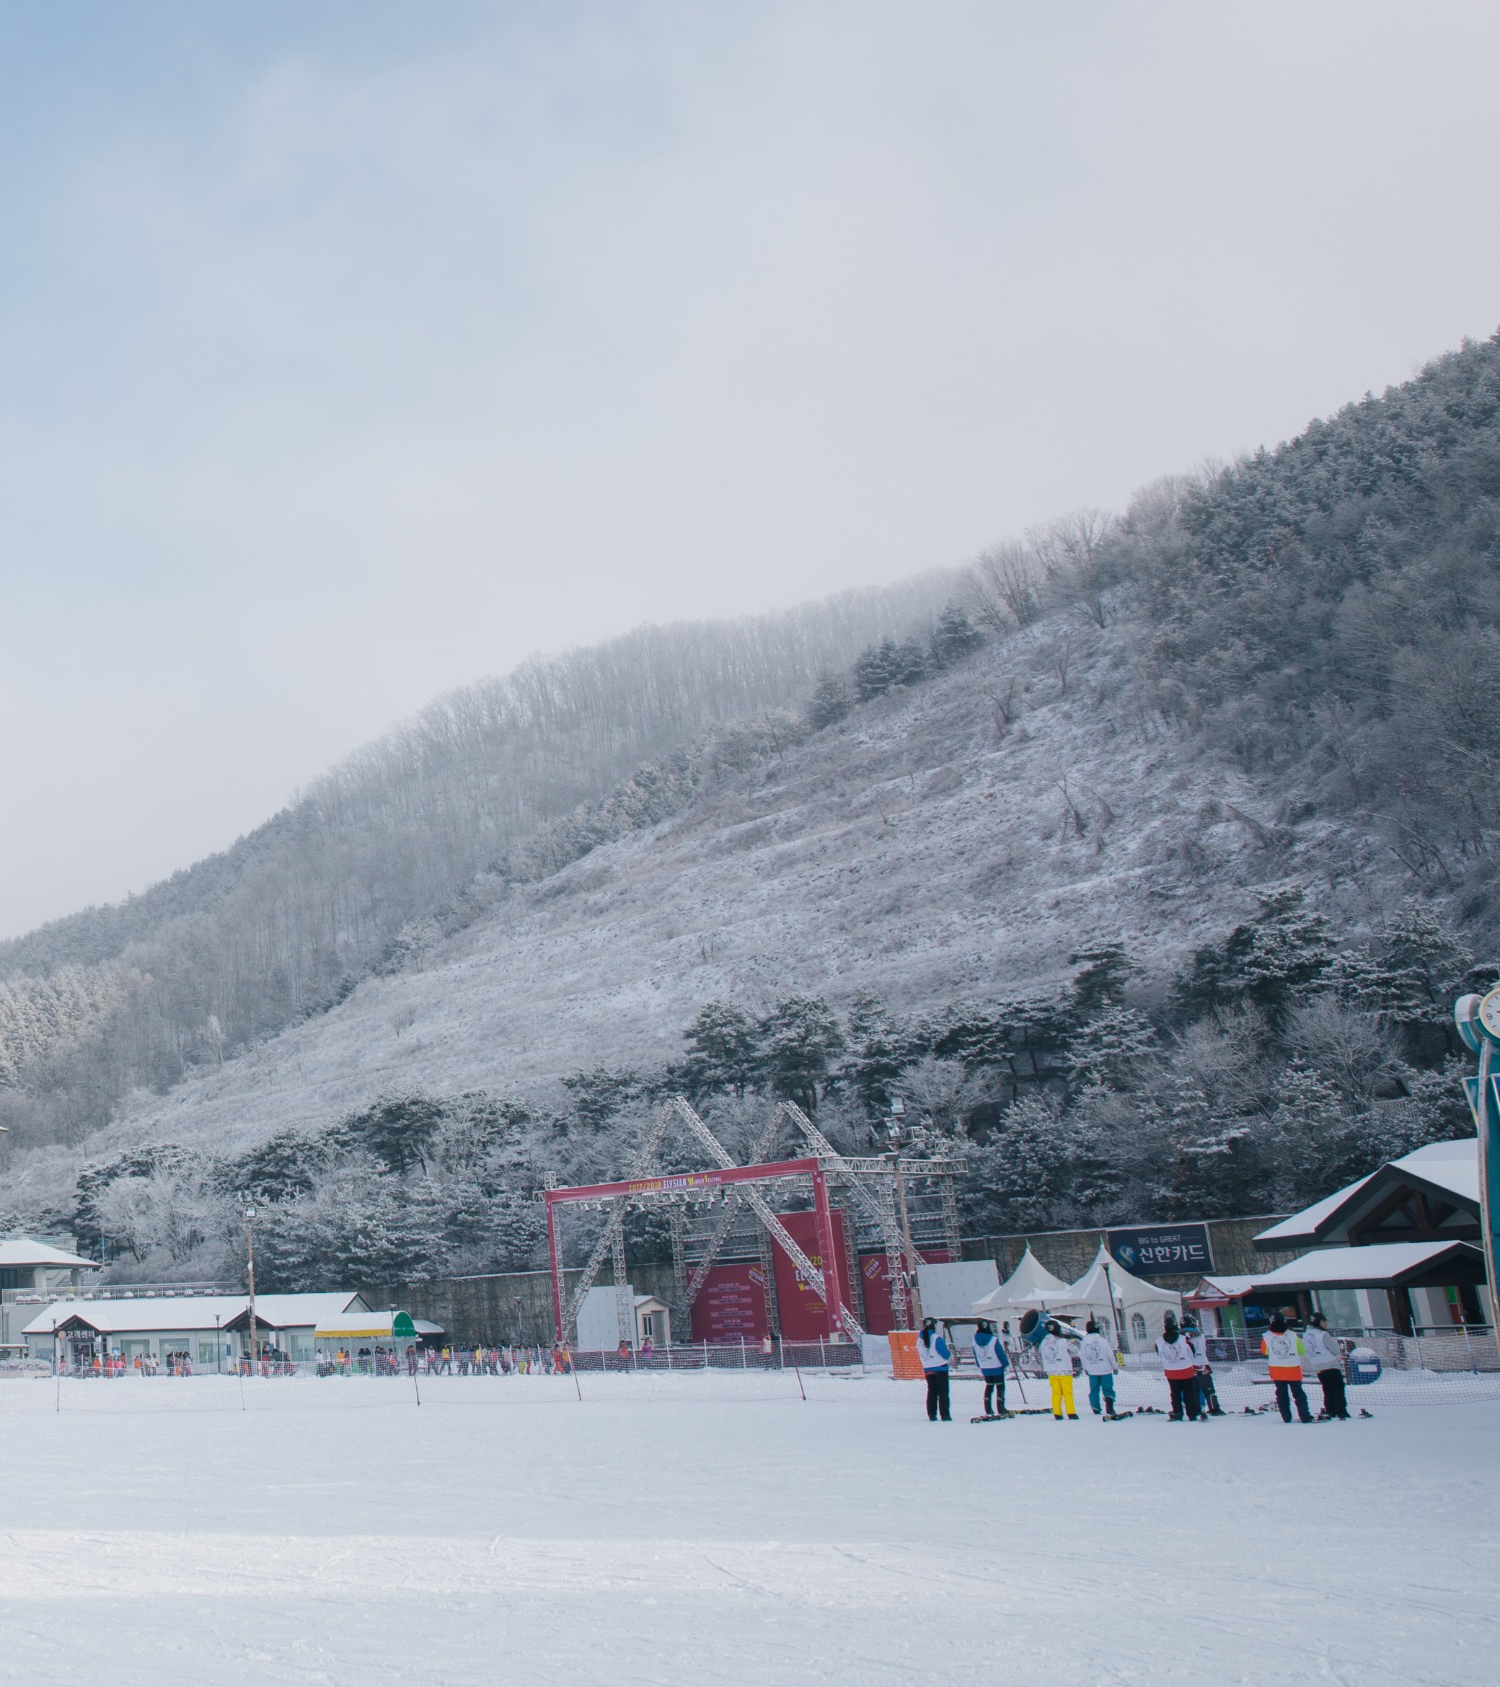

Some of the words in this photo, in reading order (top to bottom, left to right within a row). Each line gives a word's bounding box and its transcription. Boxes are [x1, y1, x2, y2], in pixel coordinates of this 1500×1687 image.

[628, 1181, 661, 1192] 2017/2018
[663, 1178, 687, 1189] ELYSIAN
[1138, 1237, 1150, 1245] BIG
[1159, 1234, 1181, 1243] GREAT
[1138, 1244, 1205, 1264] 신한카드
[66, 1330, 95, 1339] 고객센터
